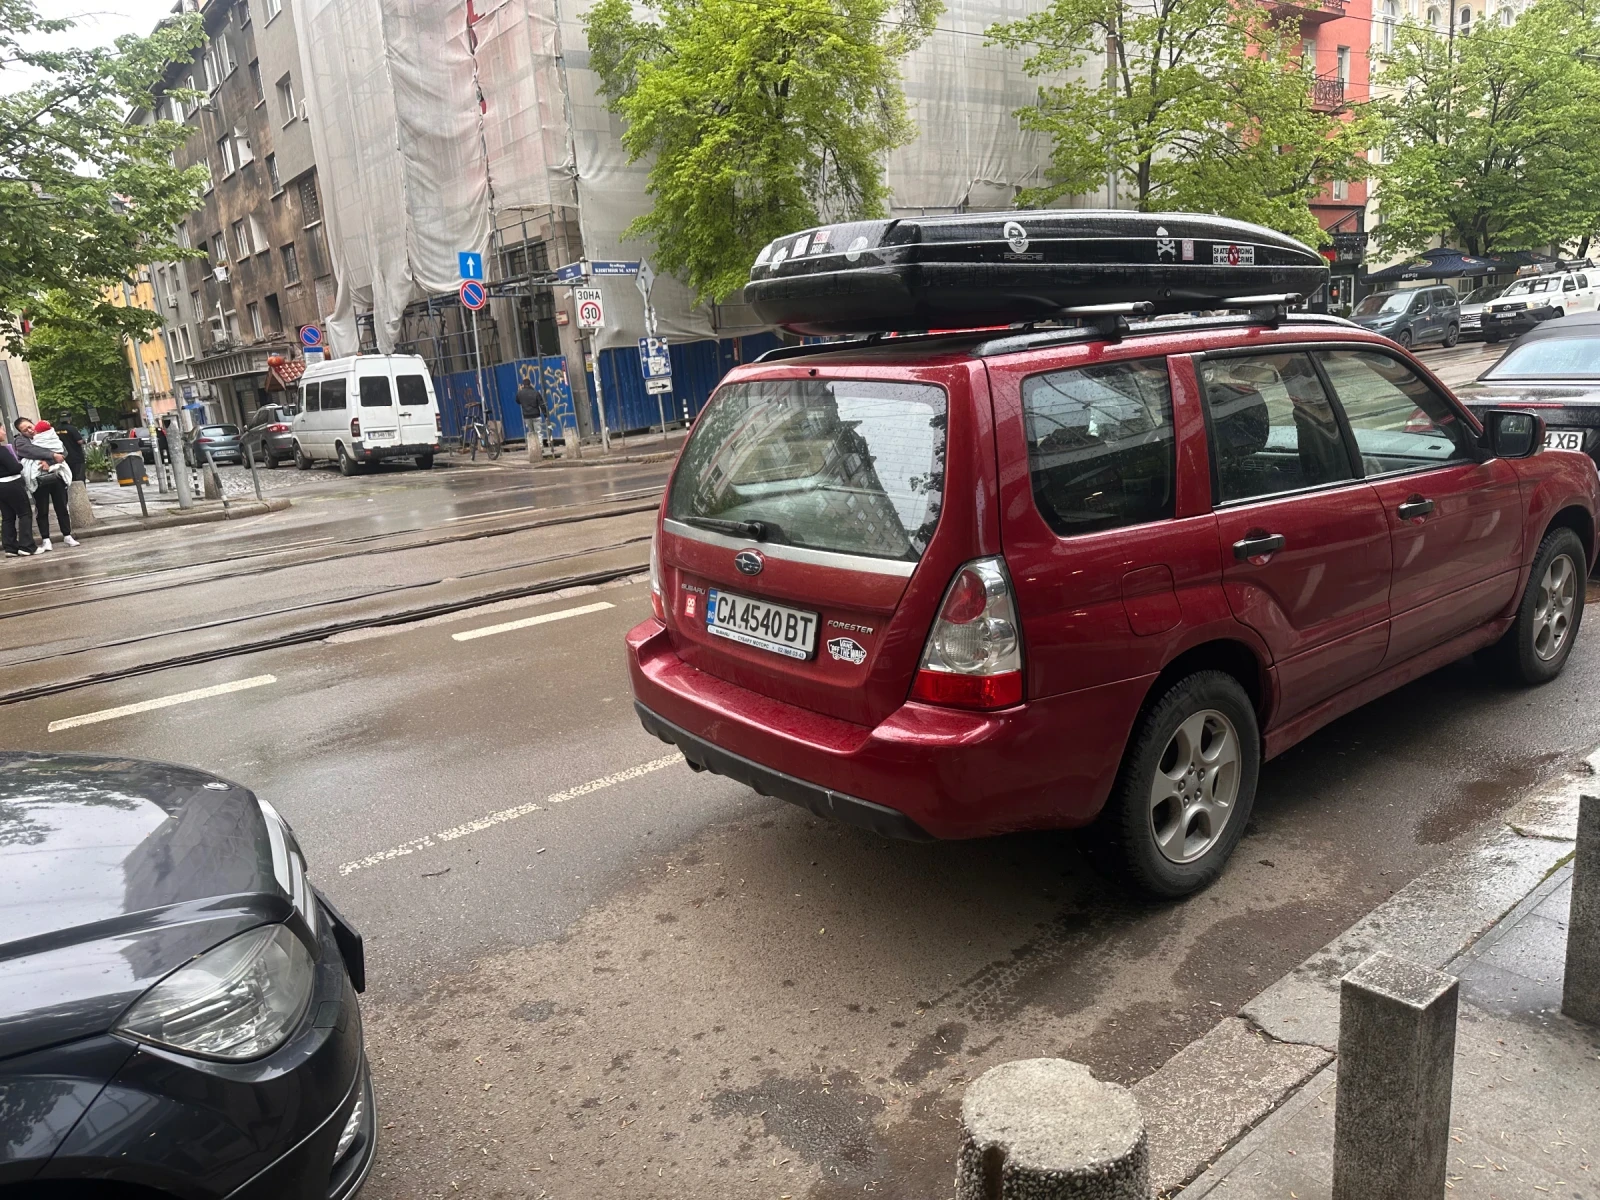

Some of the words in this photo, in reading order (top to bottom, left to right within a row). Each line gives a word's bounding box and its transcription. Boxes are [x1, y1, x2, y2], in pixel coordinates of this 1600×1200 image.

[584, 307, 598, 320] 30
[1555, 433, 1579, 450] XB
[707, 610, 715, 620] BG
[716, 596, 737, 628] CA
[740, 602, 782, 639] 4540
[784, 612, 813, 646] BT
[827, 619, 874, 635] FORESTER
